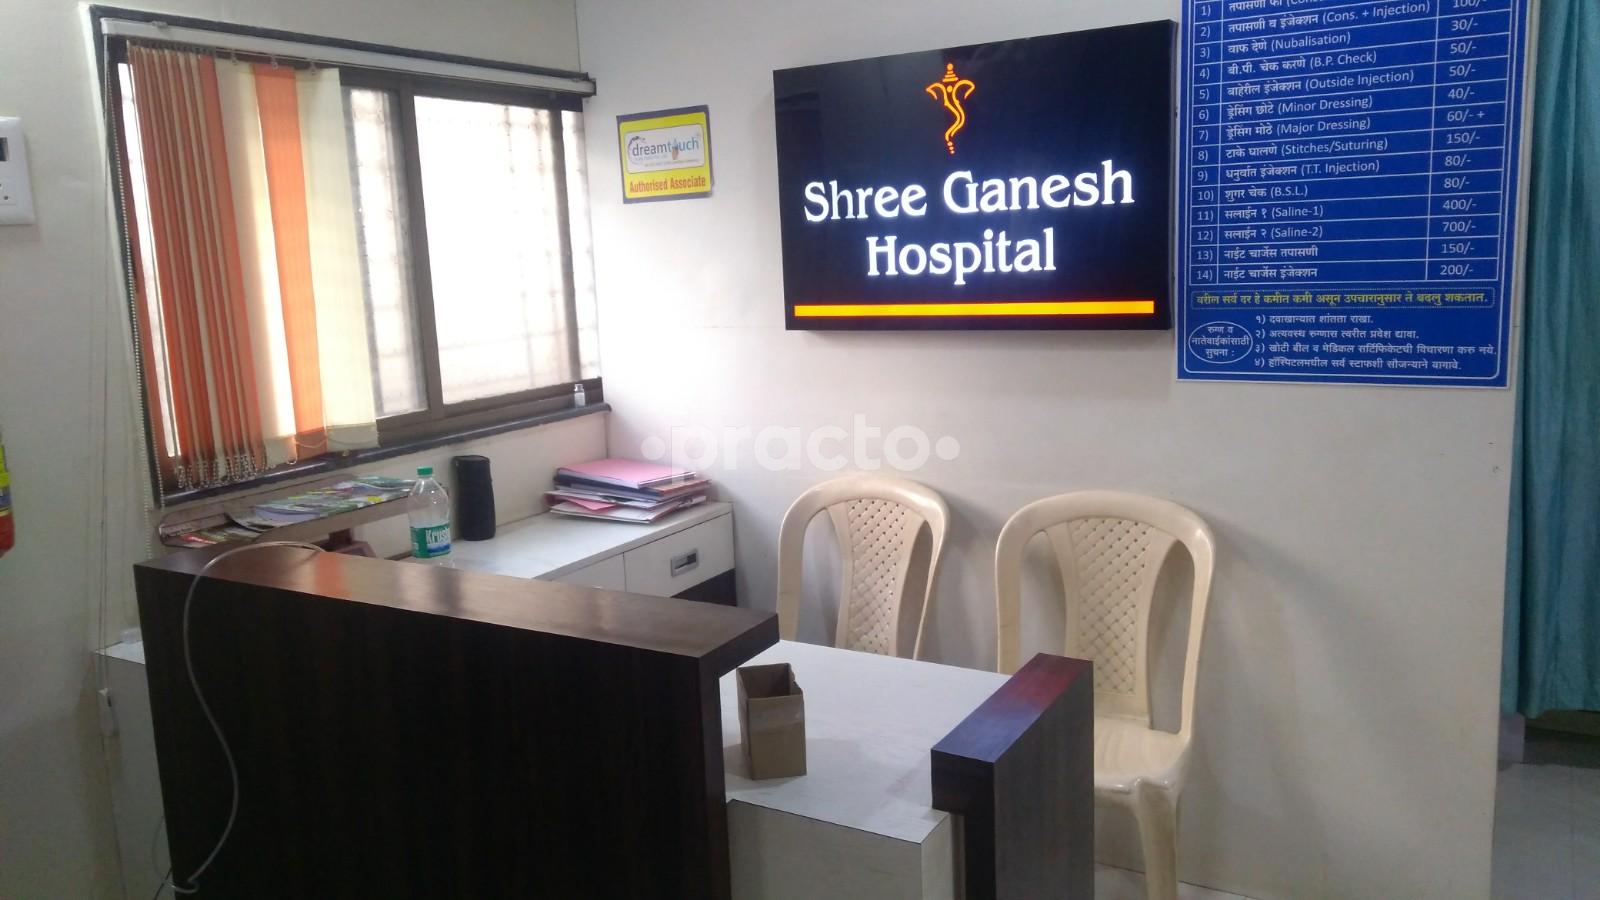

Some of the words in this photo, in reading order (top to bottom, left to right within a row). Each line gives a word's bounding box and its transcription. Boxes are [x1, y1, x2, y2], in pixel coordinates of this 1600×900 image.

[1201, 6, 1211, 16] 1)
[1201, 27, 1210, 38] 2)
[1229, 18, 1265, 33] तपासणी
[1323, 12, 1358, 24] (Cons.
[1373, 2, 1430, 19] Injection)
[1200, 47, 1210, 59] 3)
[1271, 32, 1350, 51] (Nubalisation)
[1451, 18, 1478, 31] 30/-
[1200, 68, 1209, 79] 4)
[1260, 60, 1279, 71] चेक
[1283, 56, 1306, 69] करणे
[1309, 54, 1334, 69] (B.P.
[1338, 51, 1377, 65] Check)
[1451, 40, 1477, 54] 50/-
[1200, 89, 1209, 100] 5)
[1306, 76, 1354, 91] (Outside
[1357, 71, 1414, 86] Injection)
[1449, 64, 1476, 77] 50/-
[1199, 110, 1209, 121] 6)
[1278, 99, 1316, 114] (Minor
[1320, 96, 1372, 109] Dressing)
[1448, 86, 1475, 99] 40/-
[1199, 130, 1208, 141] 7)
[1277, 120, 1314, 136] (Major
[1318, 118, 1371, 131] Dressing)
[1198, 150, 1208, 161] 8)
[1281, 138, 1388, 156] (Stitches/Suturing)
[1447, 131, 1480, 144] 150/-
[1198, 170, 1208, 181] 9)
[1302, 163, 1322, 176] (T.T.
[1325, 160, 1379, 174] Injection)
[1445, 154, 1471, 167] 80/-
[630, 178, 667, 192] Authorised
[670, 176, 705, 189] Associate
[804, 180, 927, 222] Shree
[943, 159, 1135, 214] Ganesh
[1199, 190, 1214, 201] 10)
[1249, 186, 1267, 198] चेक
[1271, 185, 1308, 198] (B.S.L.)
[1444, 176, 1470, 189] 80/-
[1198, 211, 1213, 221] 11)
[1272, 205, 1323, 219] (Saline-1)
[1443, 198, 1477, 211] 400/-
[1198, 230, 1213, 241] 12)
[1271, 226, 1323, 239] (Saline-2)
[1442, 220, 1476, 233] 700/-
[866, 228, 1056, 286] Hospital
[1197, 251, 1213, 261] 13)
[1441, 242, 1475, 255] 150/-
[1197, 270, 1212, 281] 14)
[1440, 263, 1473, 276] 200/-
